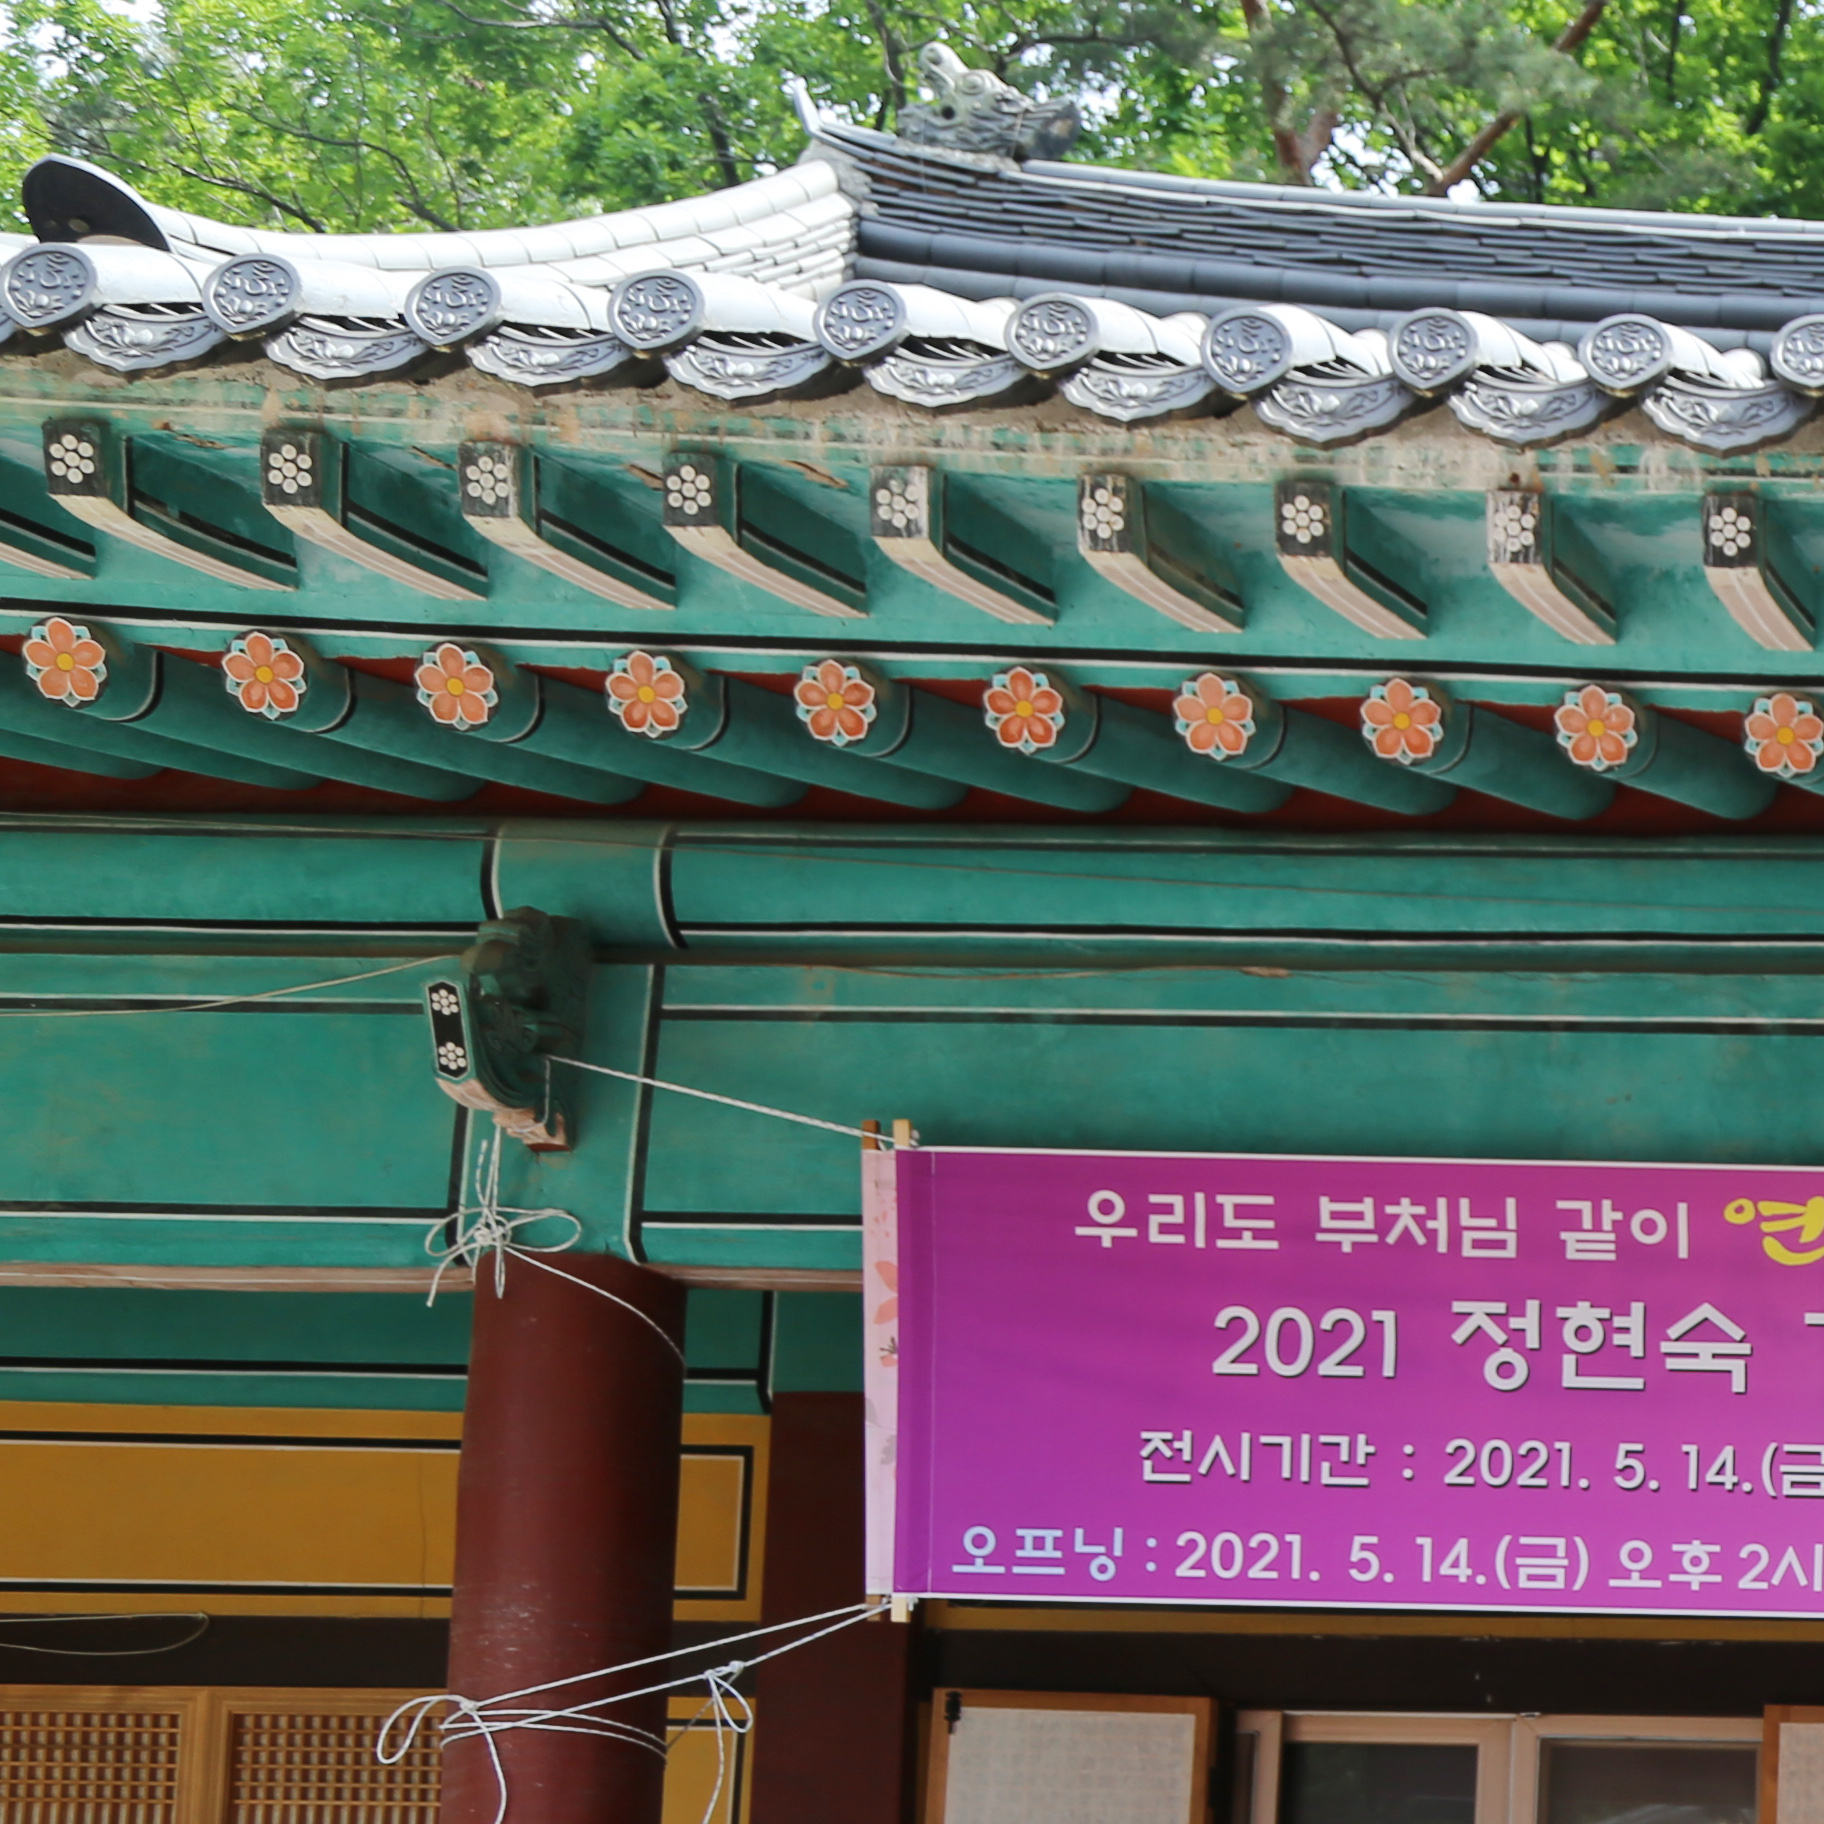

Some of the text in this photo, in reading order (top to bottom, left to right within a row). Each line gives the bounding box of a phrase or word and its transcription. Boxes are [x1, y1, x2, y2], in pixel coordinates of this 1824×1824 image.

[1073, 1188, 1281, 1252] 우리도
[1315, 1193, 1519, 1259] 부처님
[1556, 1199, 1691, 1261] 같이
[1211, 1305, 1399, 1379] 2021
[1450, 1299, 1753, 1394] 정현숙
[1138, 1430, 1377, 1488] 전시기간
[1443, 1438, 1592, 1491] 2021.
[1613, 1443, 1662, 1492] 5.
[1174, 1532, 1322, 1583] 2021.
[1347, 1535, 1396, 1583] 5.
[1415, 1534, 1592, 1592] 14.(금)
